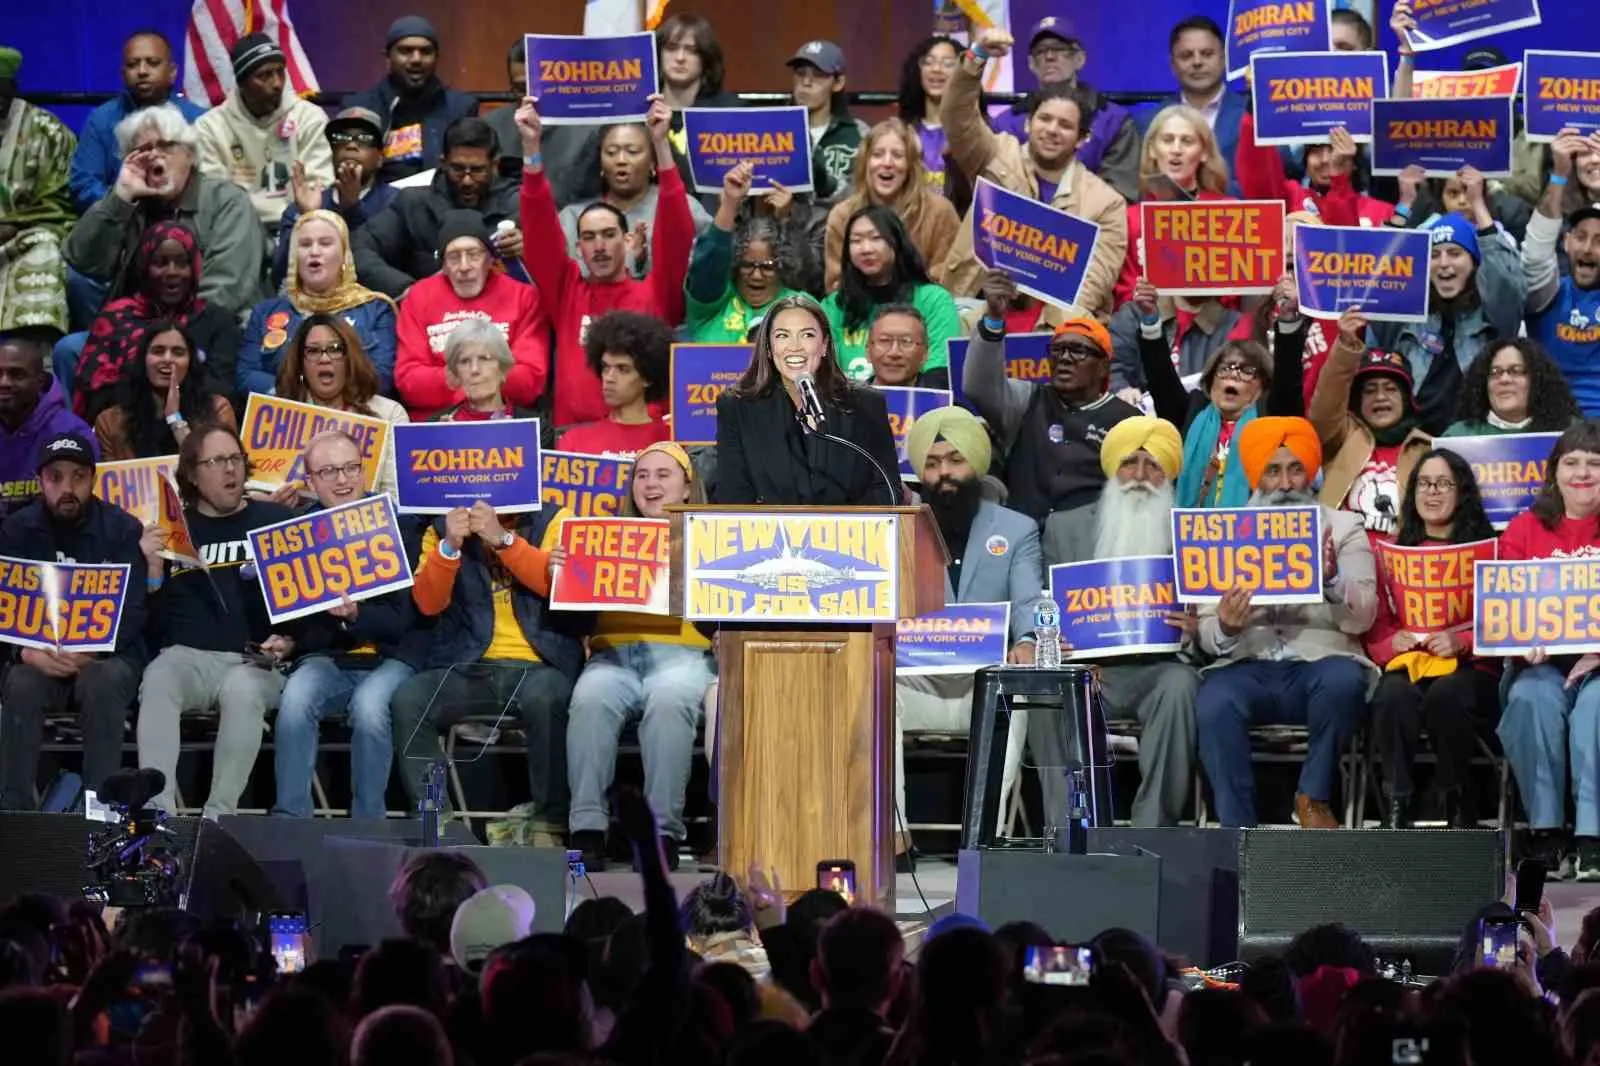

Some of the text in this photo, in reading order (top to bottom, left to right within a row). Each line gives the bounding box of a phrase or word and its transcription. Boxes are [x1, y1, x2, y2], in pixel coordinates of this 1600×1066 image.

[1235, 2, 1315, 35] ZOHRAN
[540, 58, 642, 82] ZOHRAN
[1269, 76, 1374, 100] ZOHRAN
[698, 131, 795, 153] ZOHRAN
[1388, 119, 1497, 139] ZOHRAN
[981, 207, 1079, 265] ZOHRAN
[1154, 207, 1260, 244] FREEZE
[1185, 245, 1276, 282] RENT
[1307, 251, 1414, 277] ZOHRAN
[410, 446, 525, 472] ZOHRAN
[542, 456, 600, 488] FAST
[433, 475, 459, 484] NEW
[461, 474, 490, 484] YORK
[493, 472, 520, 482] CITY
[257, 521, 315, 561] FAST
[331, 501, 389, 541] FREE
[1180, 513, 1237, 541] FAST
[1256, 511, 1313, 540] FREE
[200, 541, 256, 566] UITY
[570, 524, 670, 563] FREEZE
[691, 519, 890, 572] NEW YORK
[0, 561, 123, 595] FAS FREE
[266, 534, 401, 609] BUSES
[592, 561, 664, 600] REN
[1182, 543, 1313, 591] BUSES
[1483, 565, 1541, 593] FAST
[1560, 563, 1600, 591] FRE
[691, 579, 890, 616] NOT FOR SALE
[778, 575, 808, 593] IS
[1066, 582, 1174, 612] ZOHRAN
[0, 590, 116, 641] BUSES
[1404, 589, 1469, 628] REN
[896, 616, 992, 634] OHRAN
[898, 633, 985, 643] NEW YORK CITY
